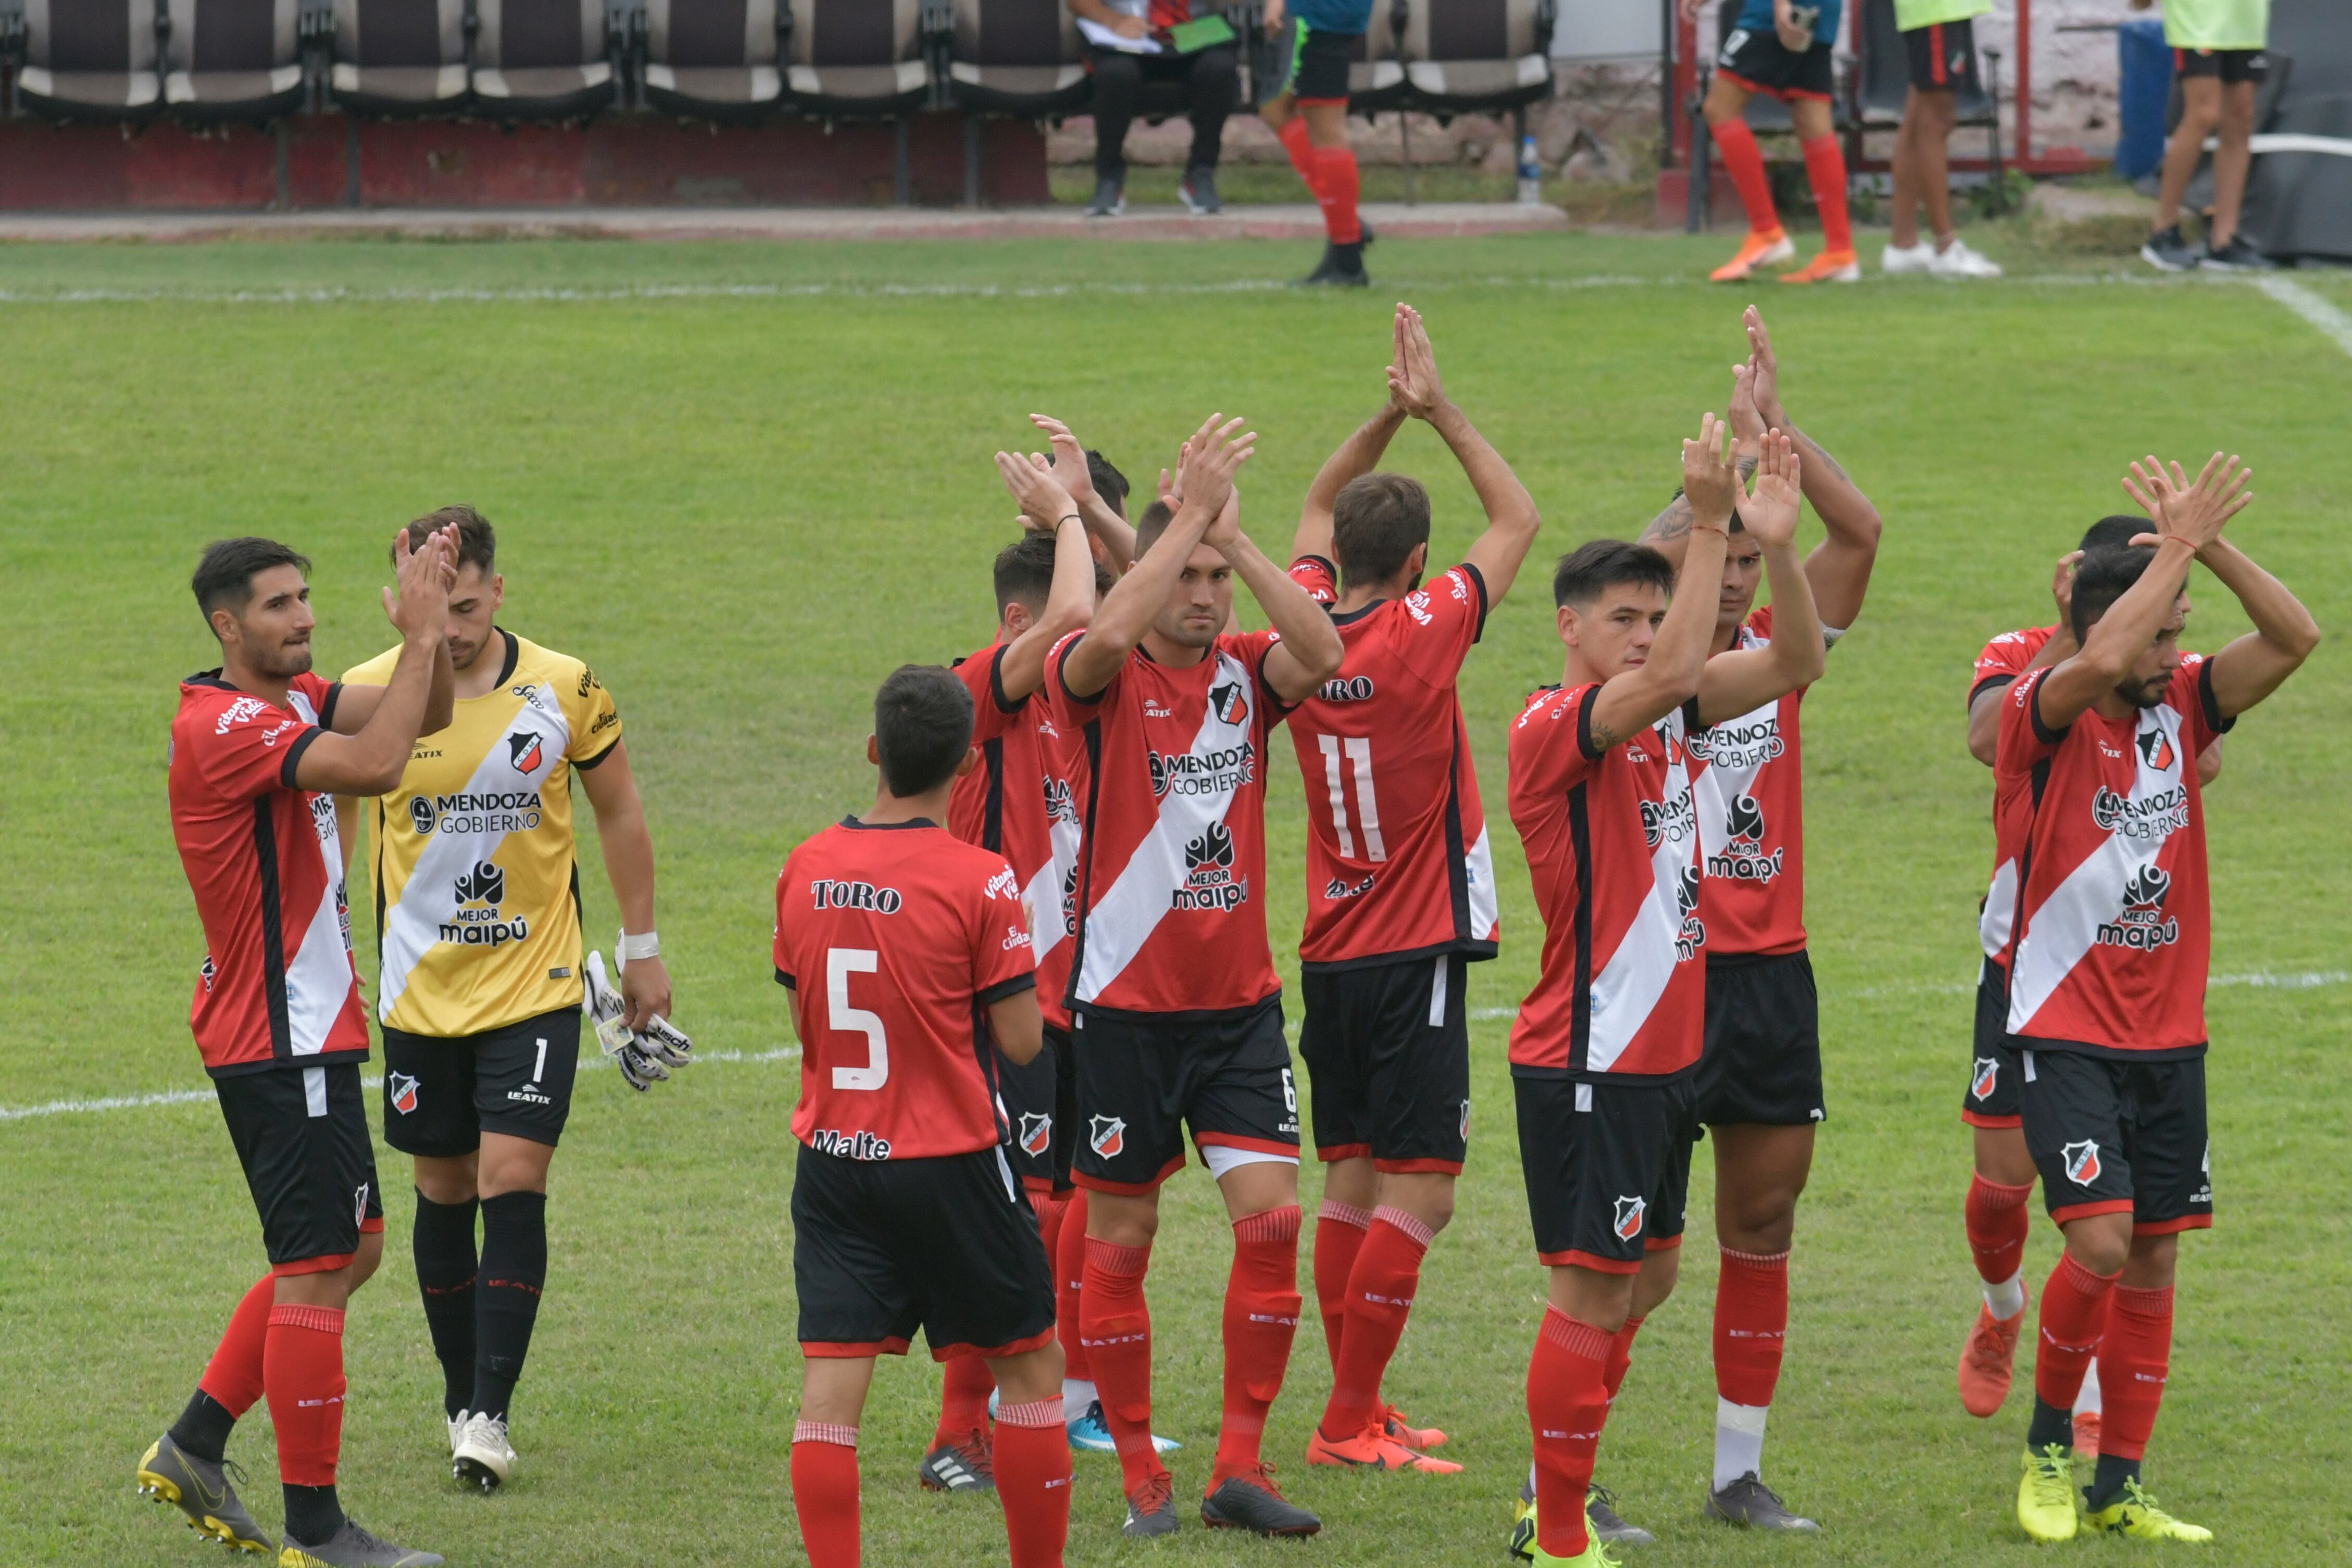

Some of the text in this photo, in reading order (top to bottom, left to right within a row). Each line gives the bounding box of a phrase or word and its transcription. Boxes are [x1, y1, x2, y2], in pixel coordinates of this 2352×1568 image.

[512, 685, 544, 709] Secco
[1702, 718, 1778, 747] MENDOZ
[436, 793, 542, 812] MENDOZA
[1317, 734, 1387, 861] 11
[441, 812, 540, 834] GOBIERNO
[1189, 870, 1230, 885] MEJOR
[812, 880, 901, 914] TORO
[457, 908, 498, 921] MEJOR
[2122, 911, 2158, 924] MEJO
[439, 915, 527, 947] maipú
[827, 948, 889, 1090] 5
[532, 1038, 548, 1083] 1
[507, 1091, 552, 1105] LEATIX
[1282, 1068, 1297, 1113] 6
[812, 1130, 891, 1161] Malte
